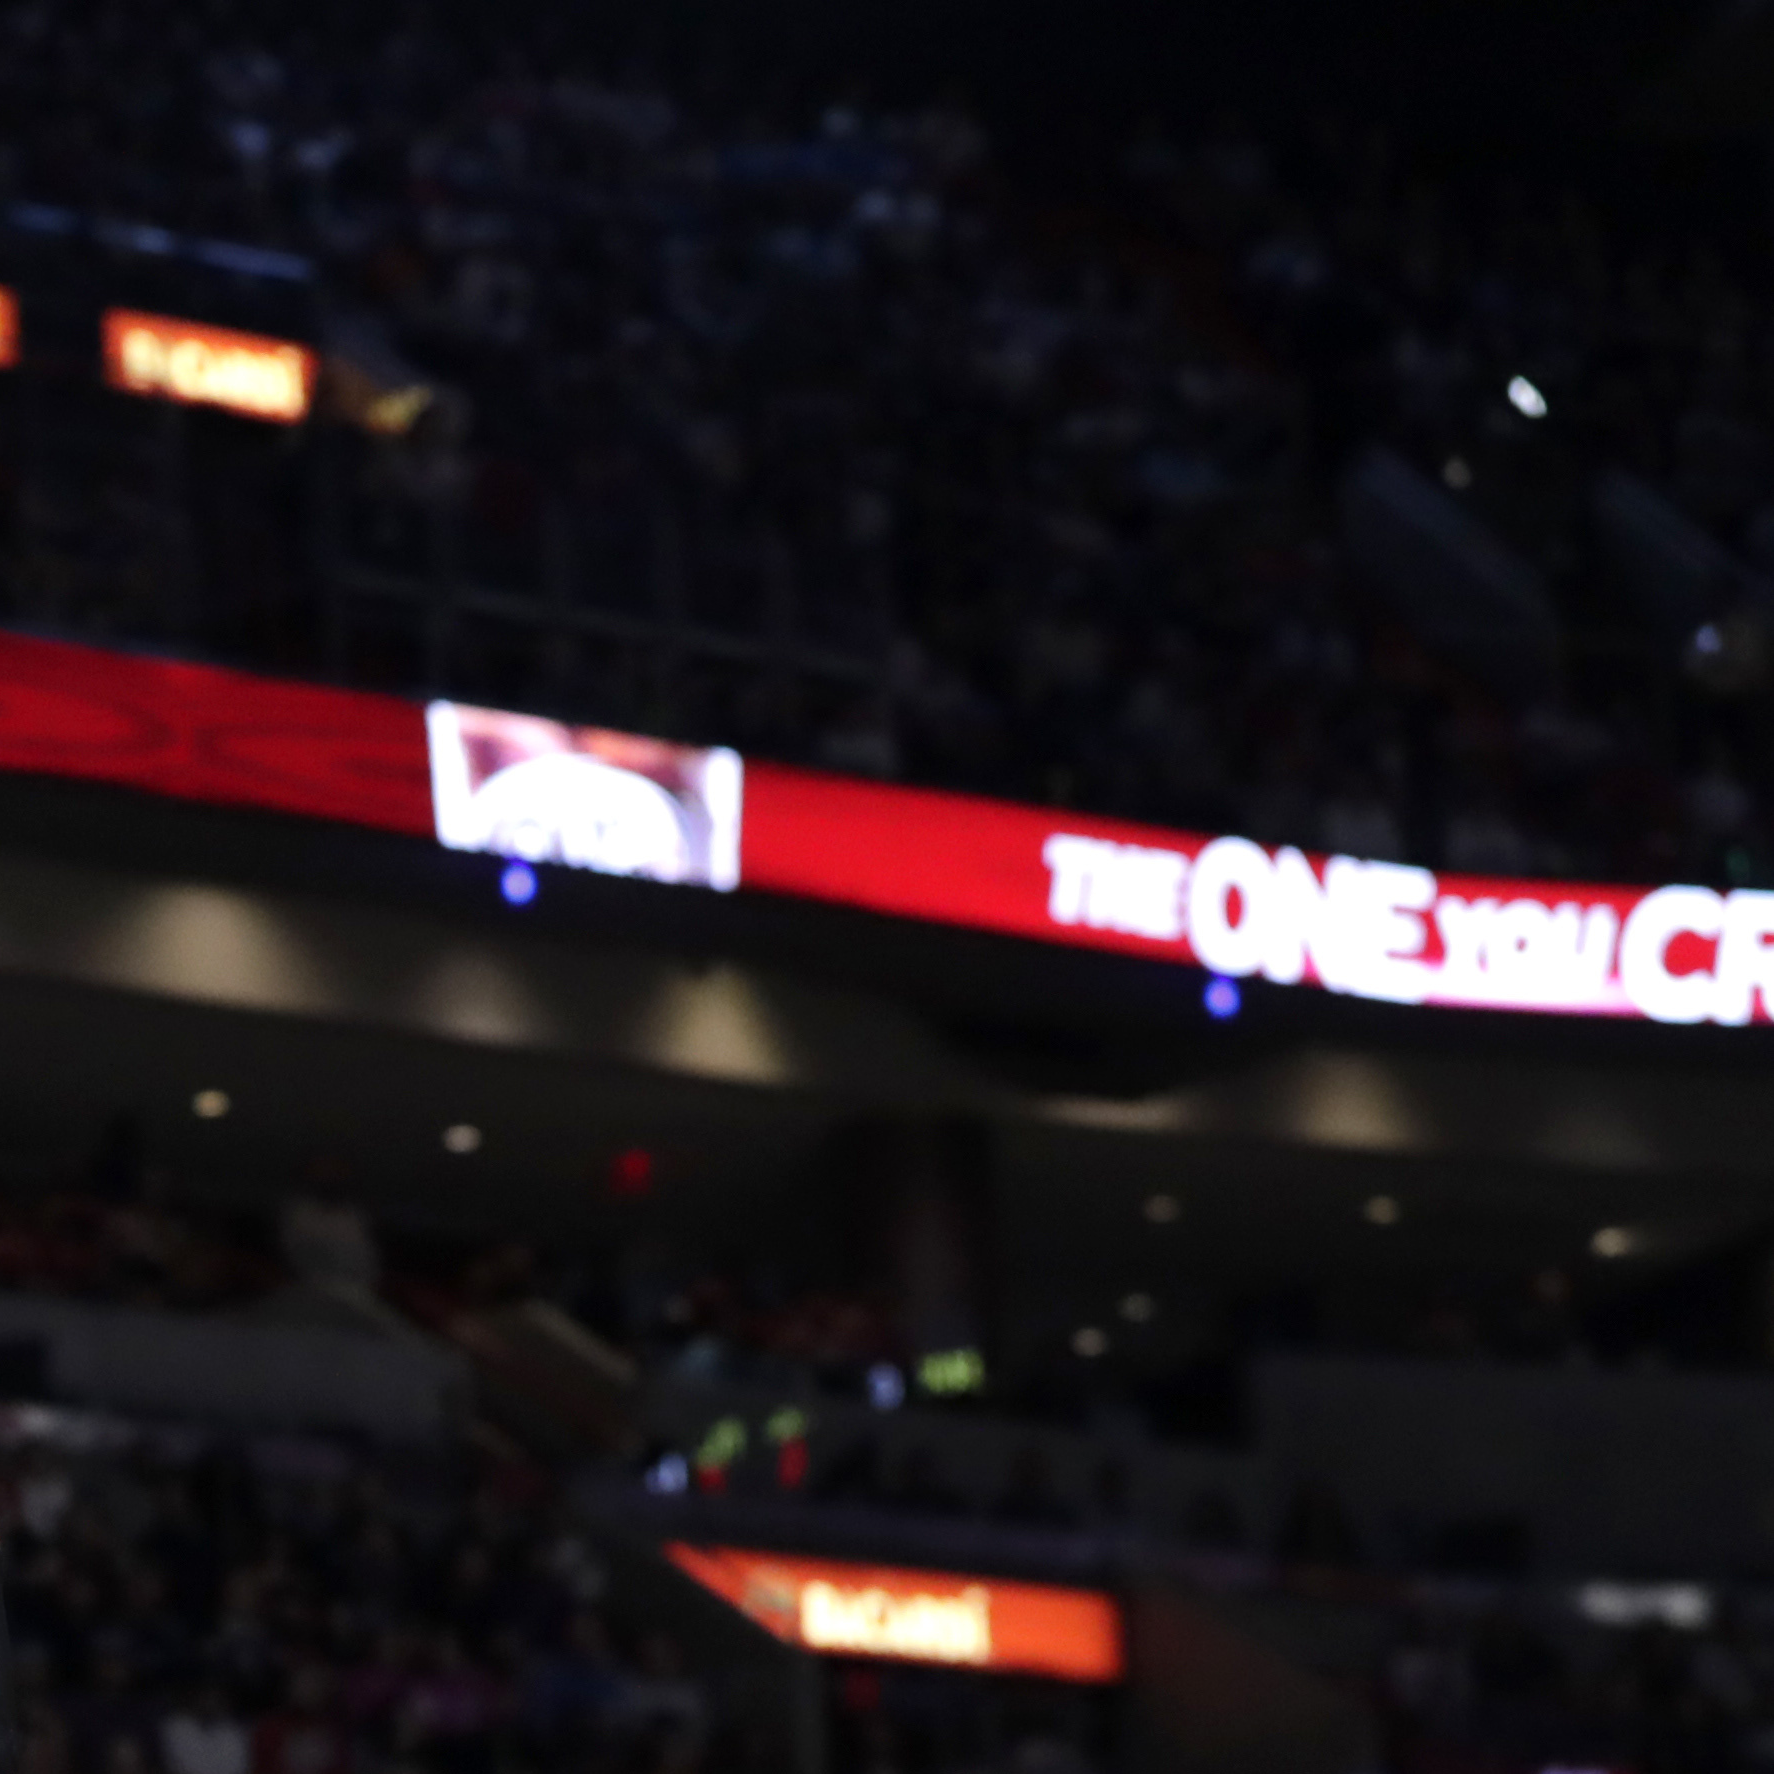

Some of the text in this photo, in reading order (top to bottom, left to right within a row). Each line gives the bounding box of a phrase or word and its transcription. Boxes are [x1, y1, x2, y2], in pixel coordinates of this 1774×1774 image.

[1042, 831, 1189, 942] THE
[1186, 836, 1438, 1004] ONE
[1434, 894, 1621, 1008] YOU
